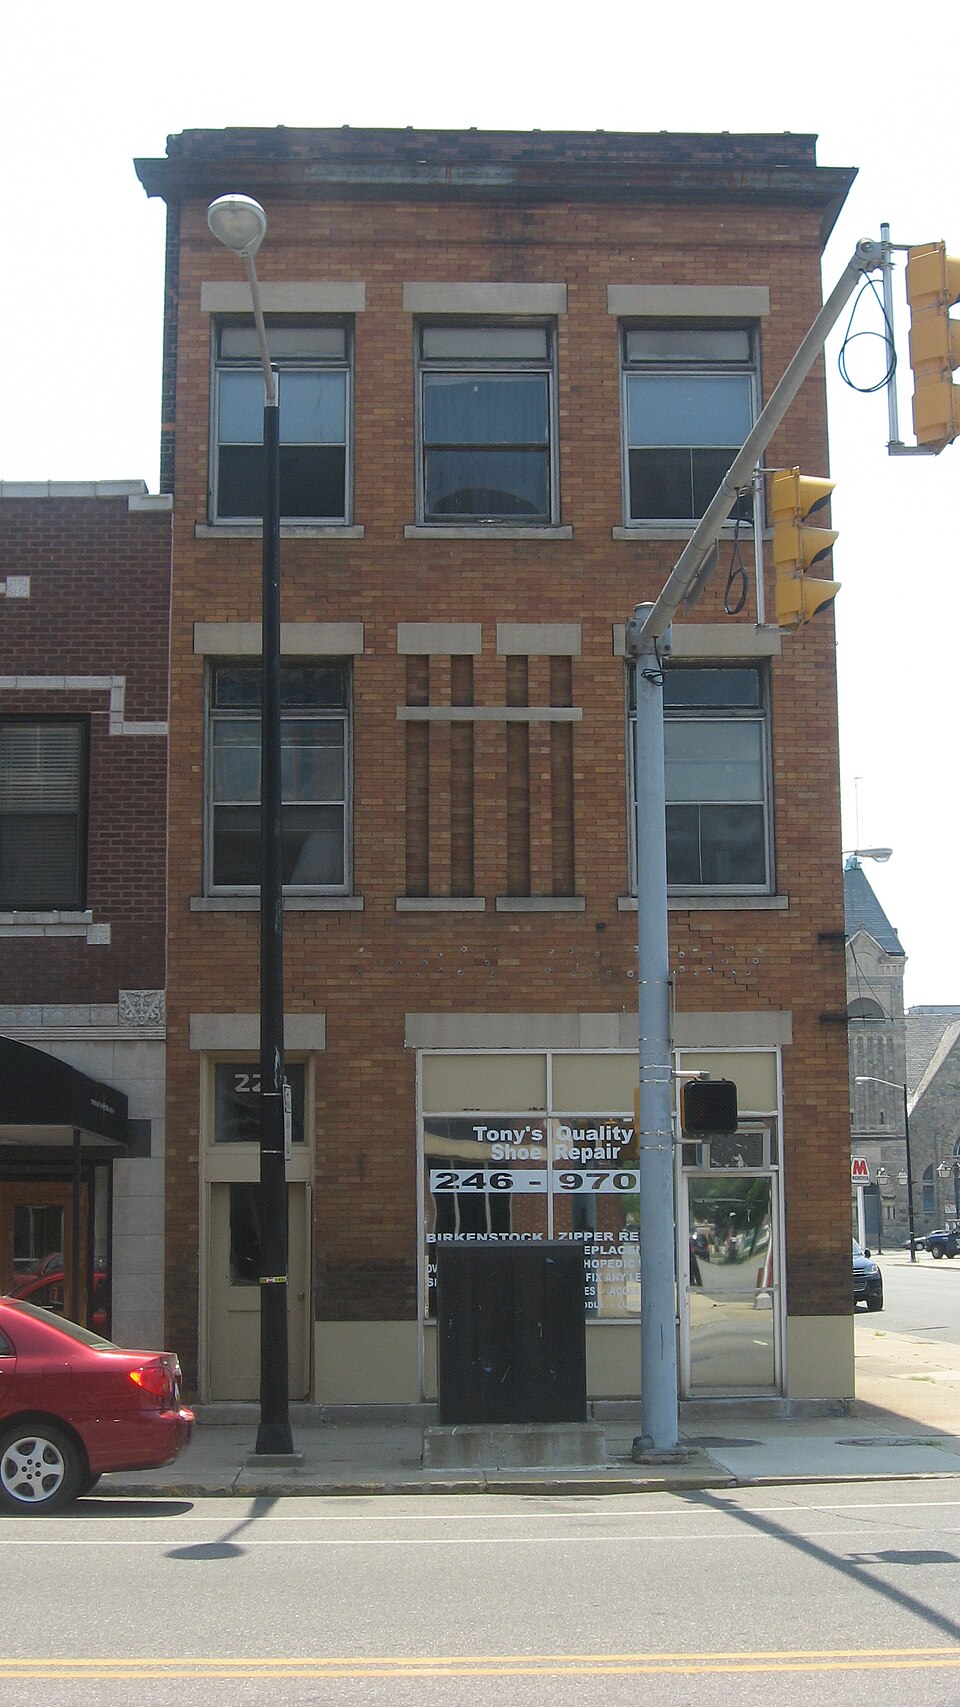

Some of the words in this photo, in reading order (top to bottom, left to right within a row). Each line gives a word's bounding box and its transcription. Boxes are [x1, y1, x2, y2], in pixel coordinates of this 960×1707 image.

[473, 1126, 543, 1145] Tony's
[556, 1126, 634, 1145] Quality
[491, 1144, 542, 1161] Shoe
[555, 1144, 621, 1163] Repair
[853, 1160, 868, 1175] M
[435, 1172, 514, 1190] 246
[558, 1173, 637, 1190] 970
[426, 1232, 544, 1243] BIRKENSTOCK
[558, 1232, 615, 1241] ZIPPER
[619, 1232, 639, 1241] RE
[584, 1245, 640, 1255] EPLACE
[584, 1259, 636, 1269] HOPEDIC
[586, 1273, 602, 1282] FIX
[629, 1273, 641, 1282] LE
[584, 1287, 596, 1296] ES
